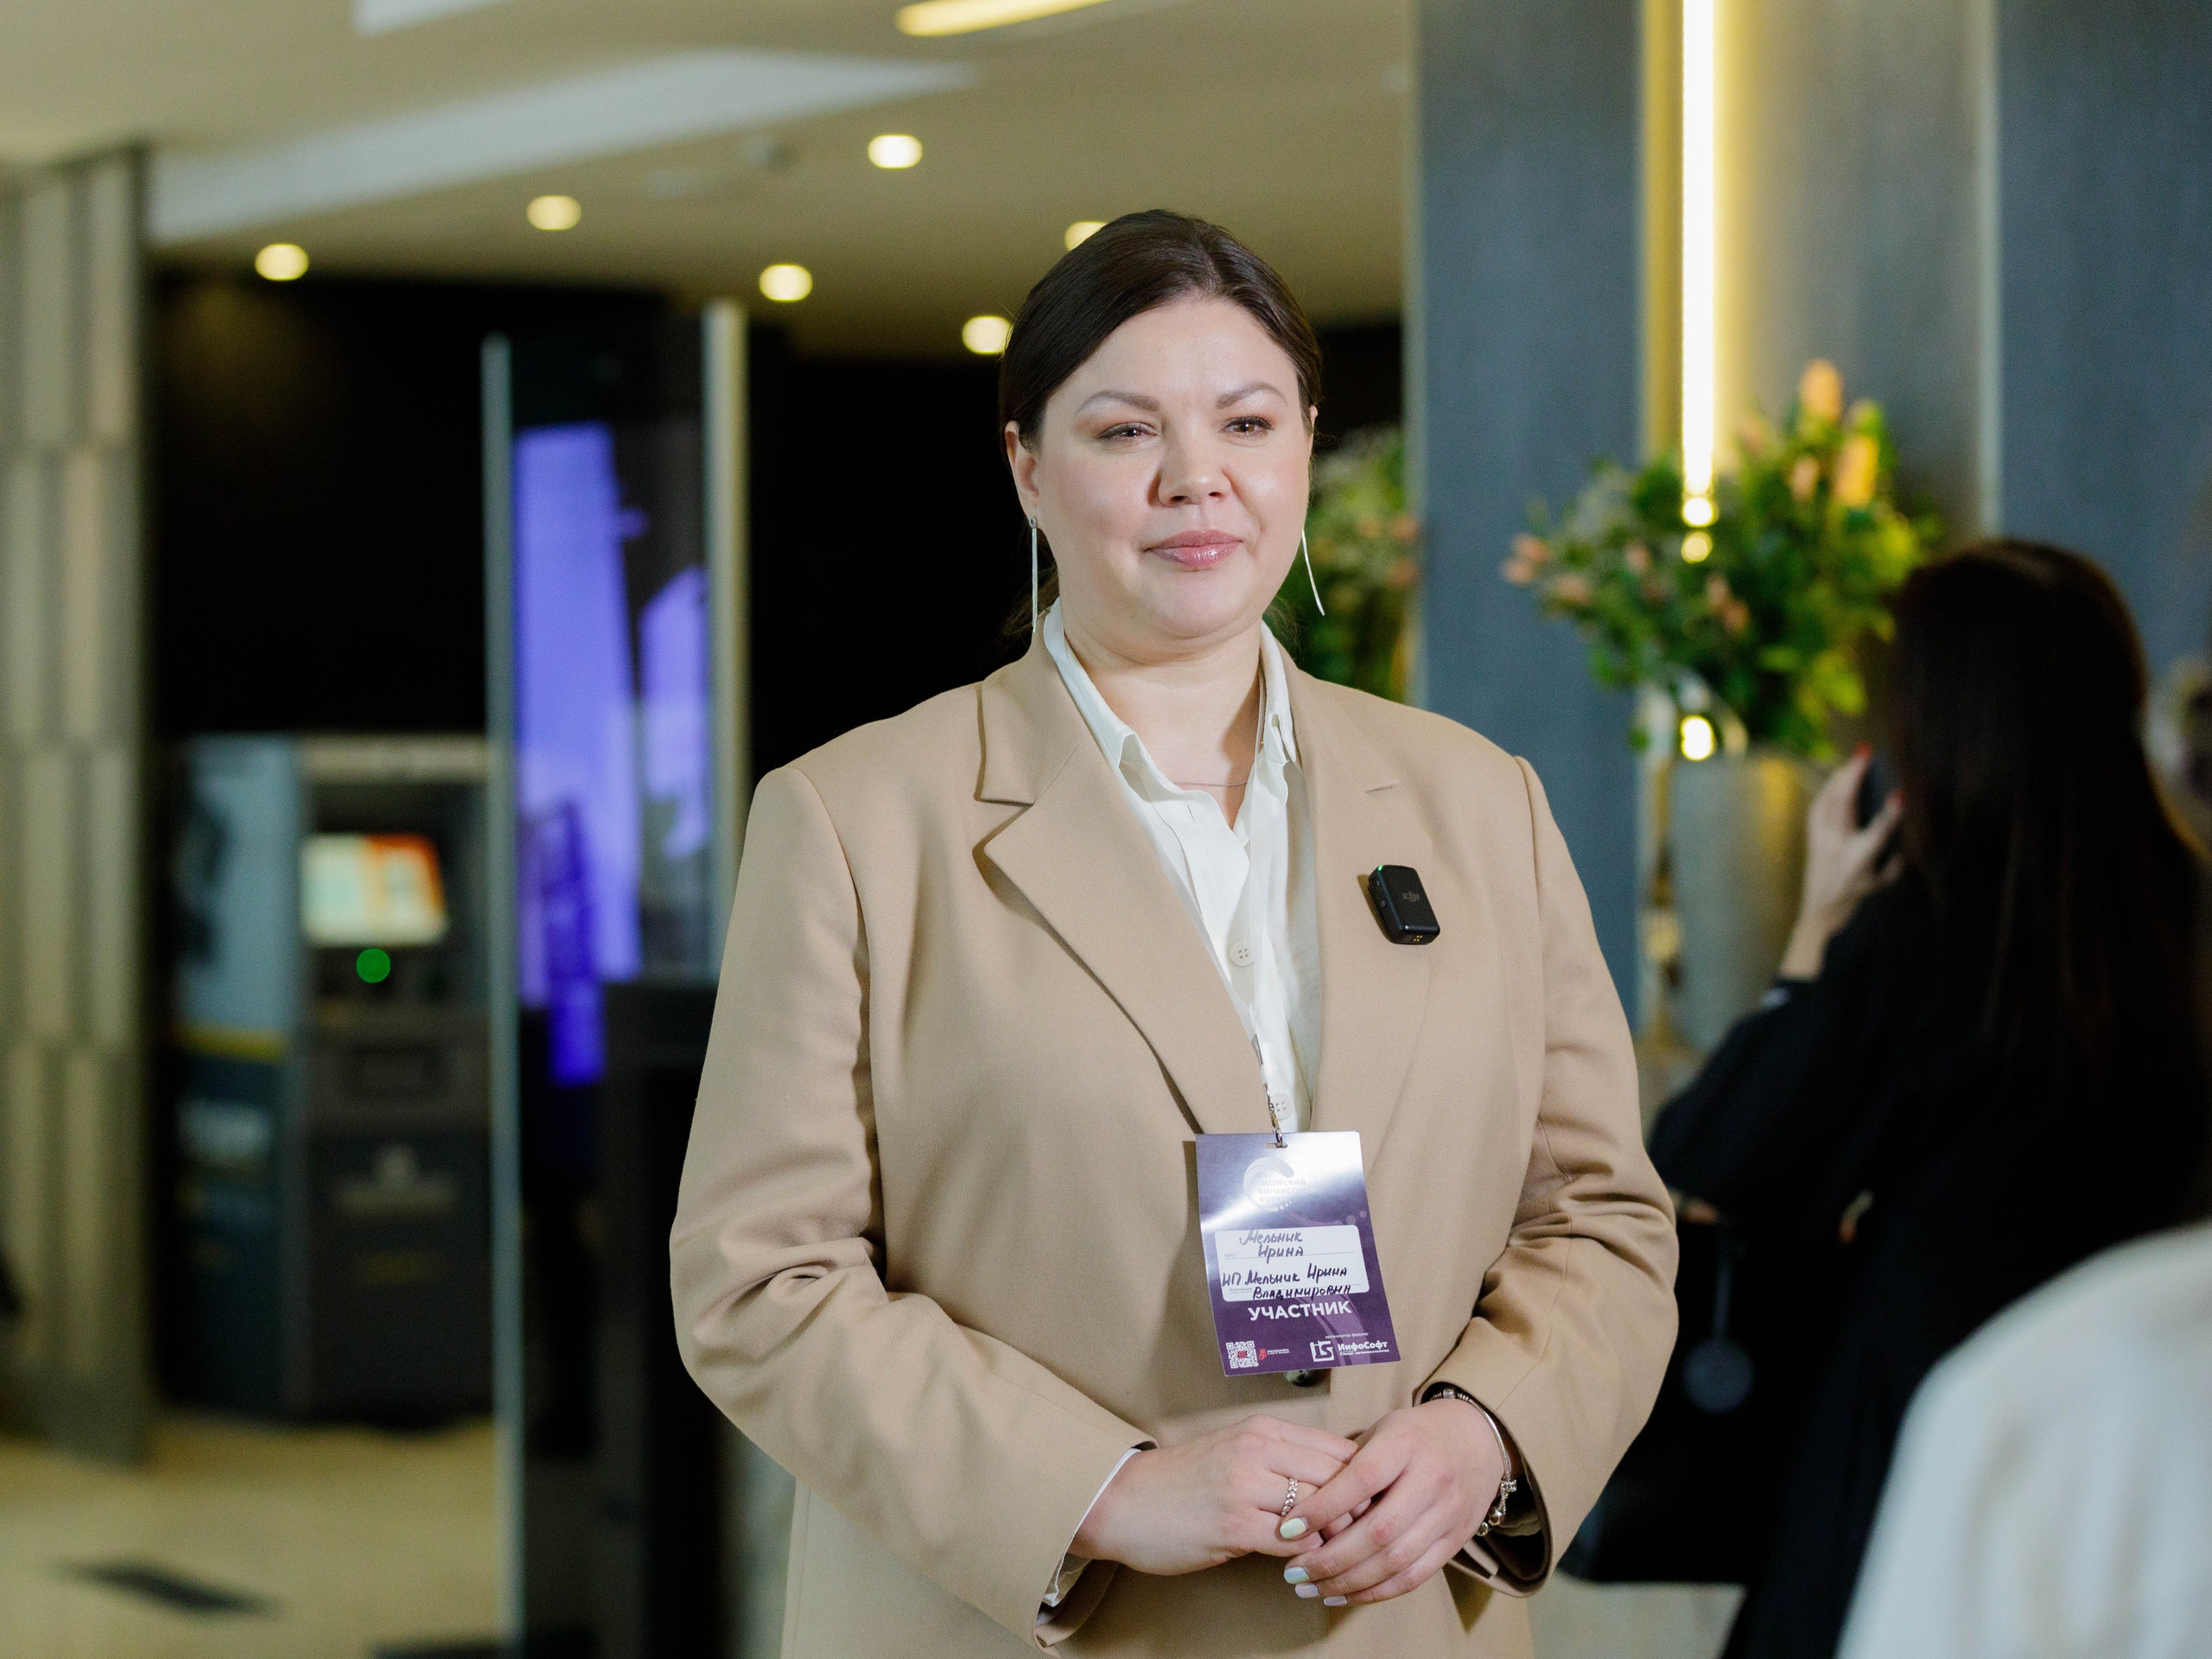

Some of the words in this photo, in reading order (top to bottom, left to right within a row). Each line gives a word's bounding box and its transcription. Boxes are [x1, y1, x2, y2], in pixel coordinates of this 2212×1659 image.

[1256, 1179, 1306, 1187] СИБИРСКИЙ
[1257, 1243, 1304, 1264] Ирина
[1222, 1272, 1242, 1287] ИП
[1244, 1269, 1300, 1286] Мельник
[1306, 1262, 1347, 1283] Ирина
[1247, 1300, 1352, 1321] УЧАСТНИК
[1337, 1340, 1388, 1352] ИнфоСофт
